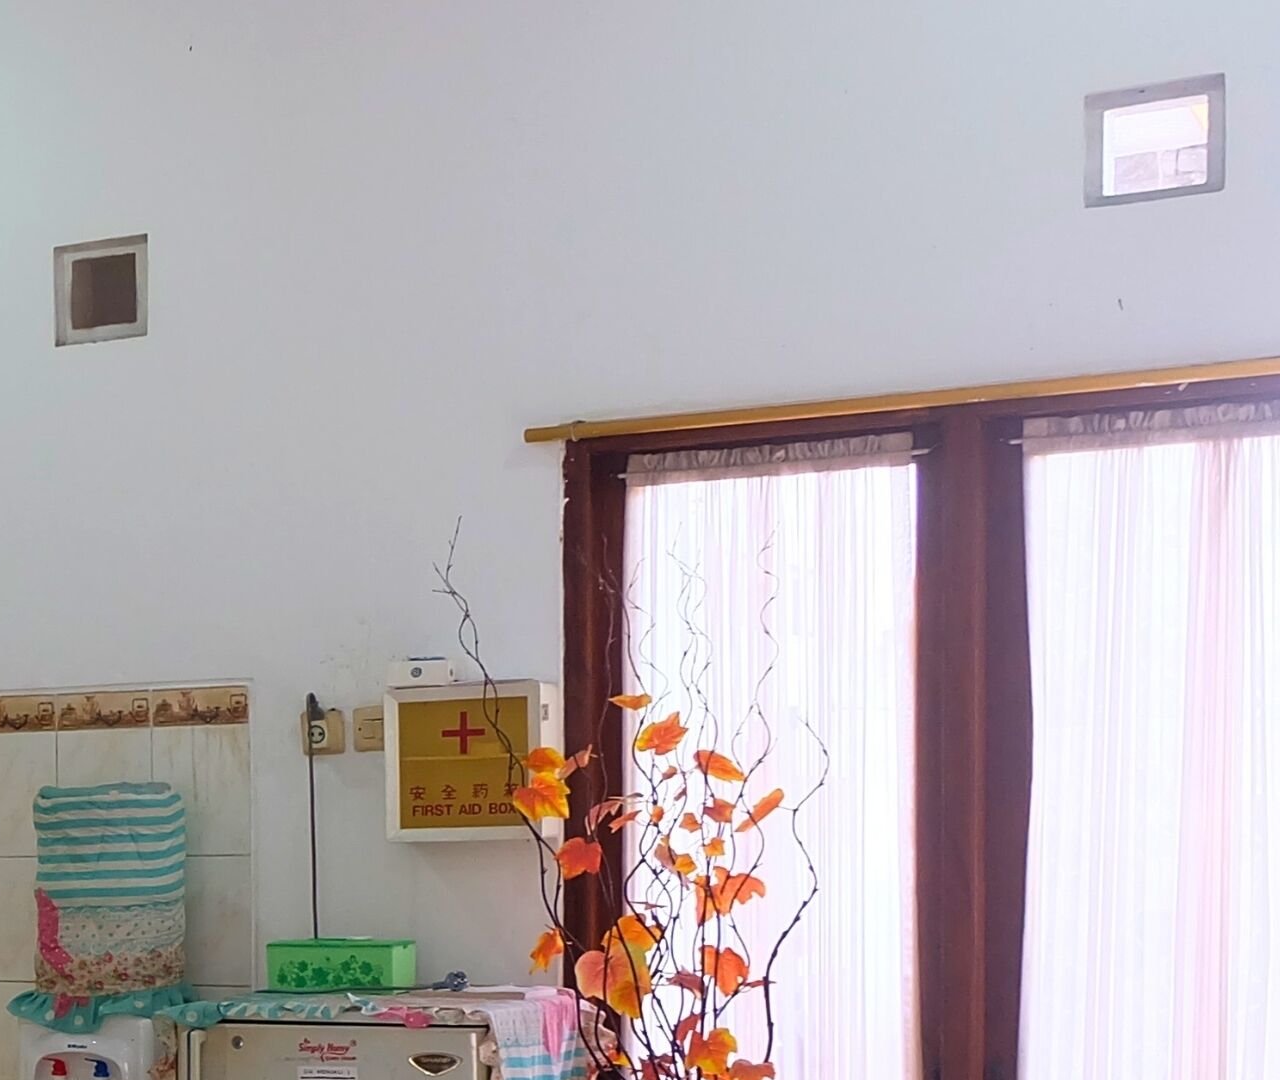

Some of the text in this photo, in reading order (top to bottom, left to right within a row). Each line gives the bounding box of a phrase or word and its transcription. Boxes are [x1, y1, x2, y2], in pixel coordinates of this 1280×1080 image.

[412, 802, 517, 817] FIRST AID BOX
